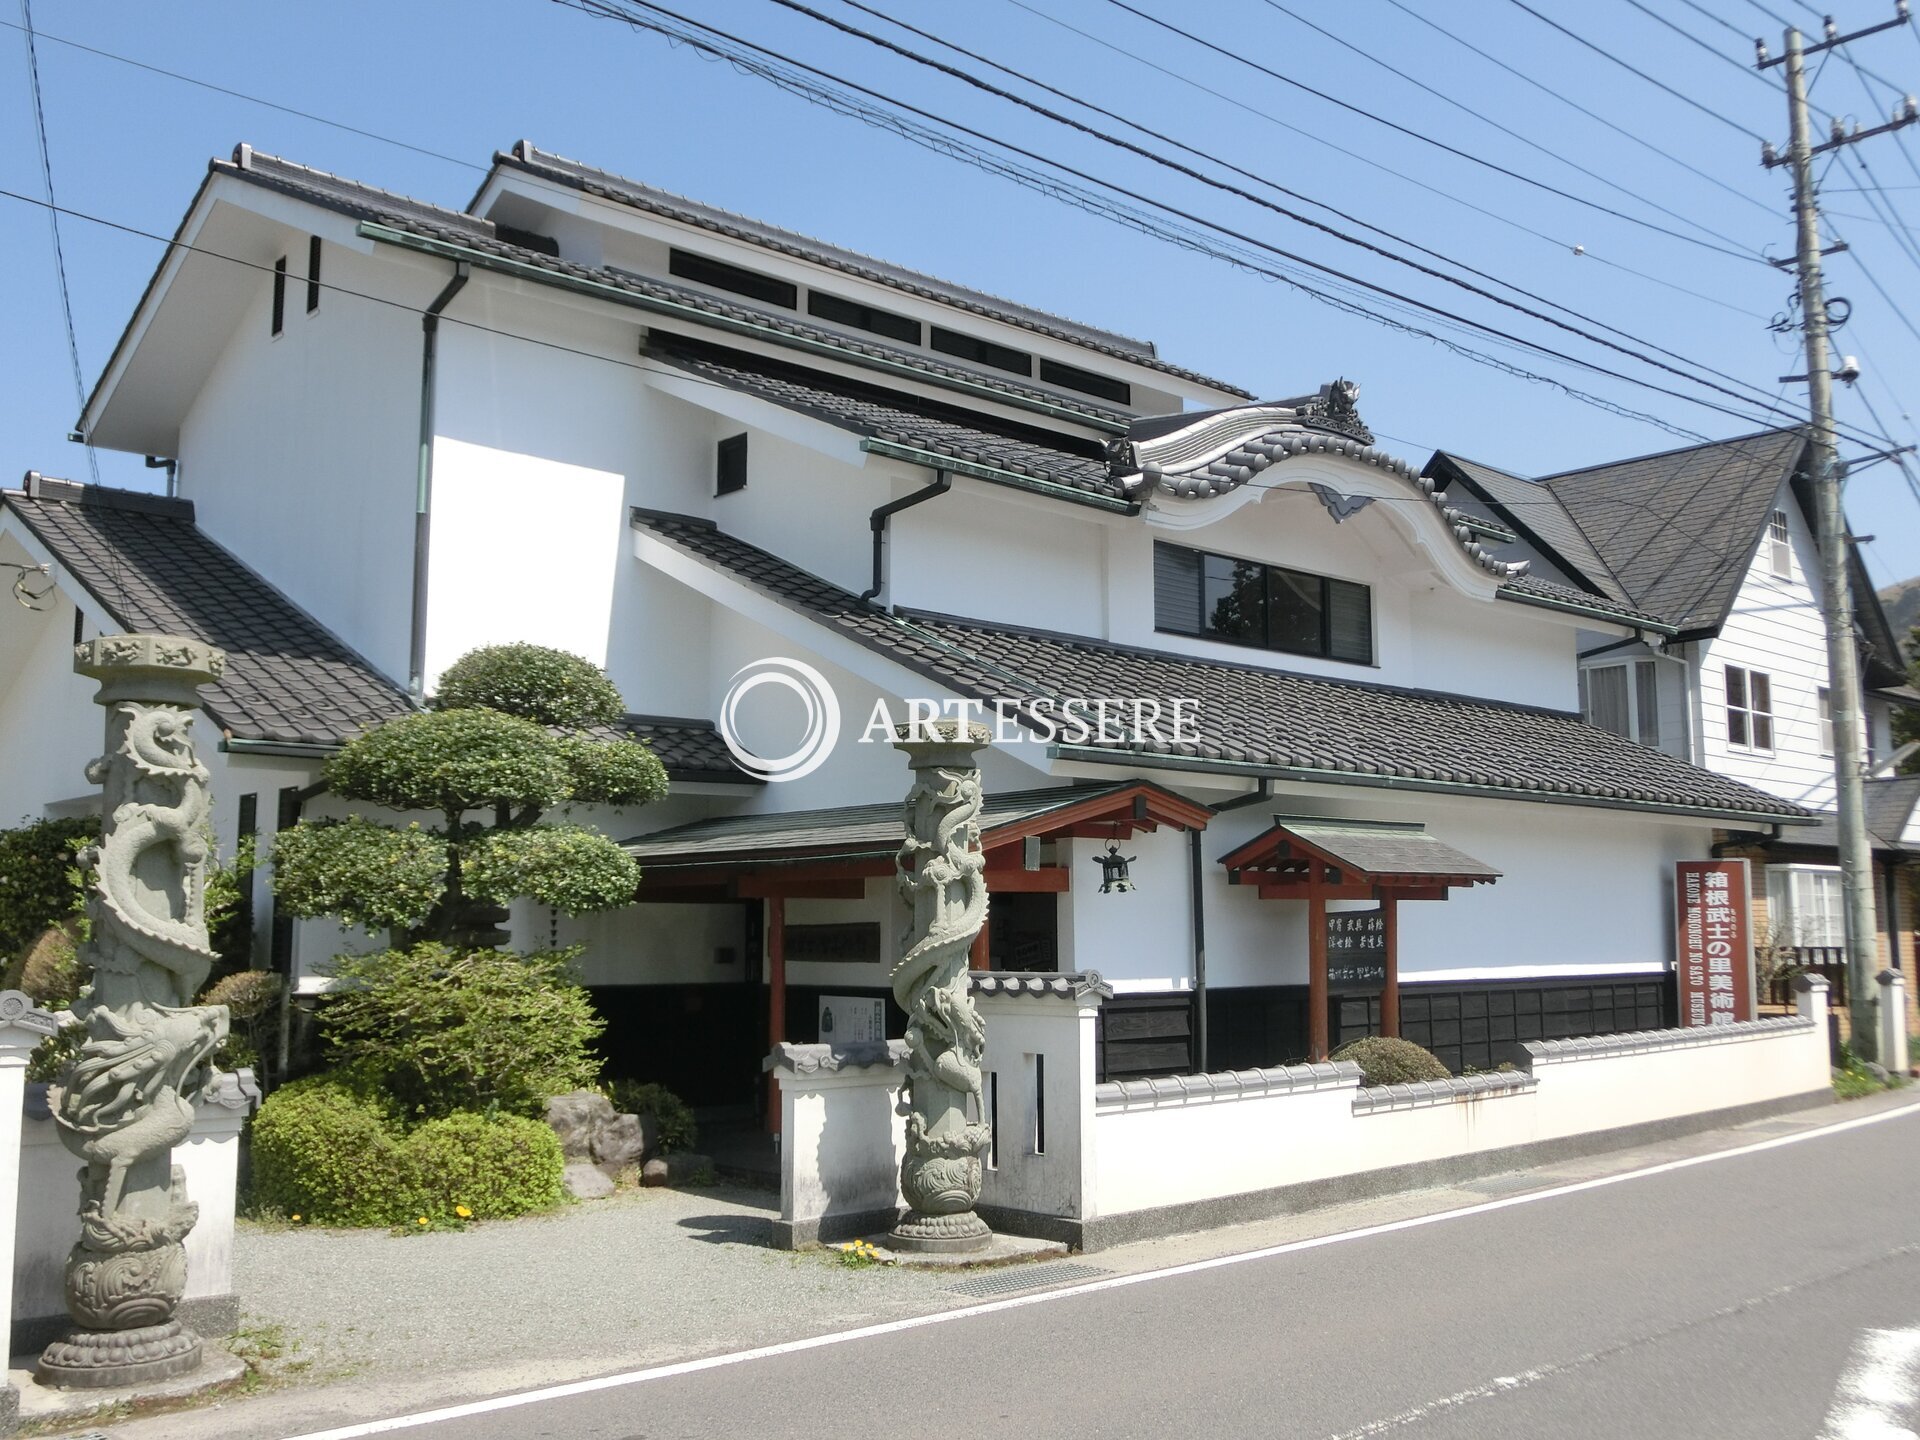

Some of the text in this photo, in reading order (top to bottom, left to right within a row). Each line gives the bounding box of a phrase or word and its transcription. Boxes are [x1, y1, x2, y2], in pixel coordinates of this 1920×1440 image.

[1686, 872, 1701, 904] HAKONE
[1689, 952, 1703, 963] NO
[1705, 871, 1735, 1025] 箱根武士の里美術館
[1689, 966, 1704, 986] SATO
[1690, 991, 1705, 1025] MUSEUM
